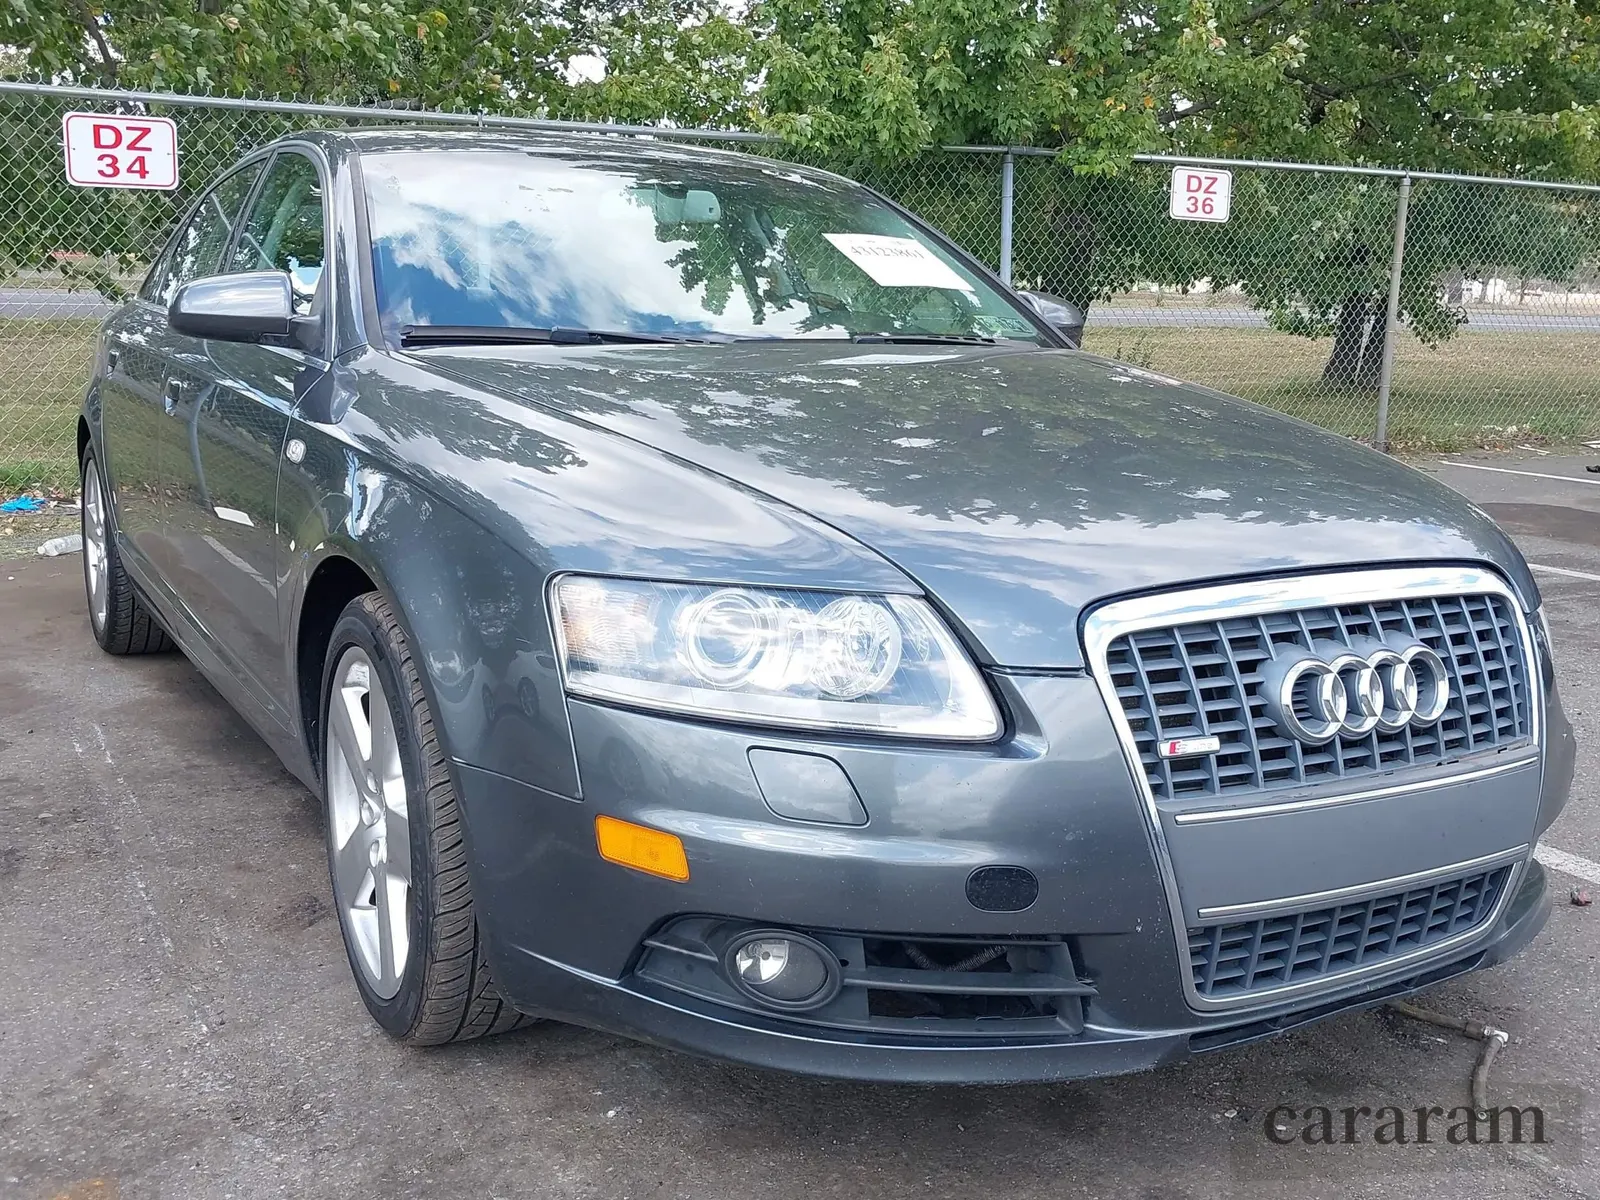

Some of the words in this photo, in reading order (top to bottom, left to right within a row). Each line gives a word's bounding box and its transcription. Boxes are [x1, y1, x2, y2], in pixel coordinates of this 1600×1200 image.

[92, 123, 153, 152] DZ
[96, 153, 150, 180] 34
[1186, 174, 1218, 195] DZ
[1186, 195, 1214, 215] 36
